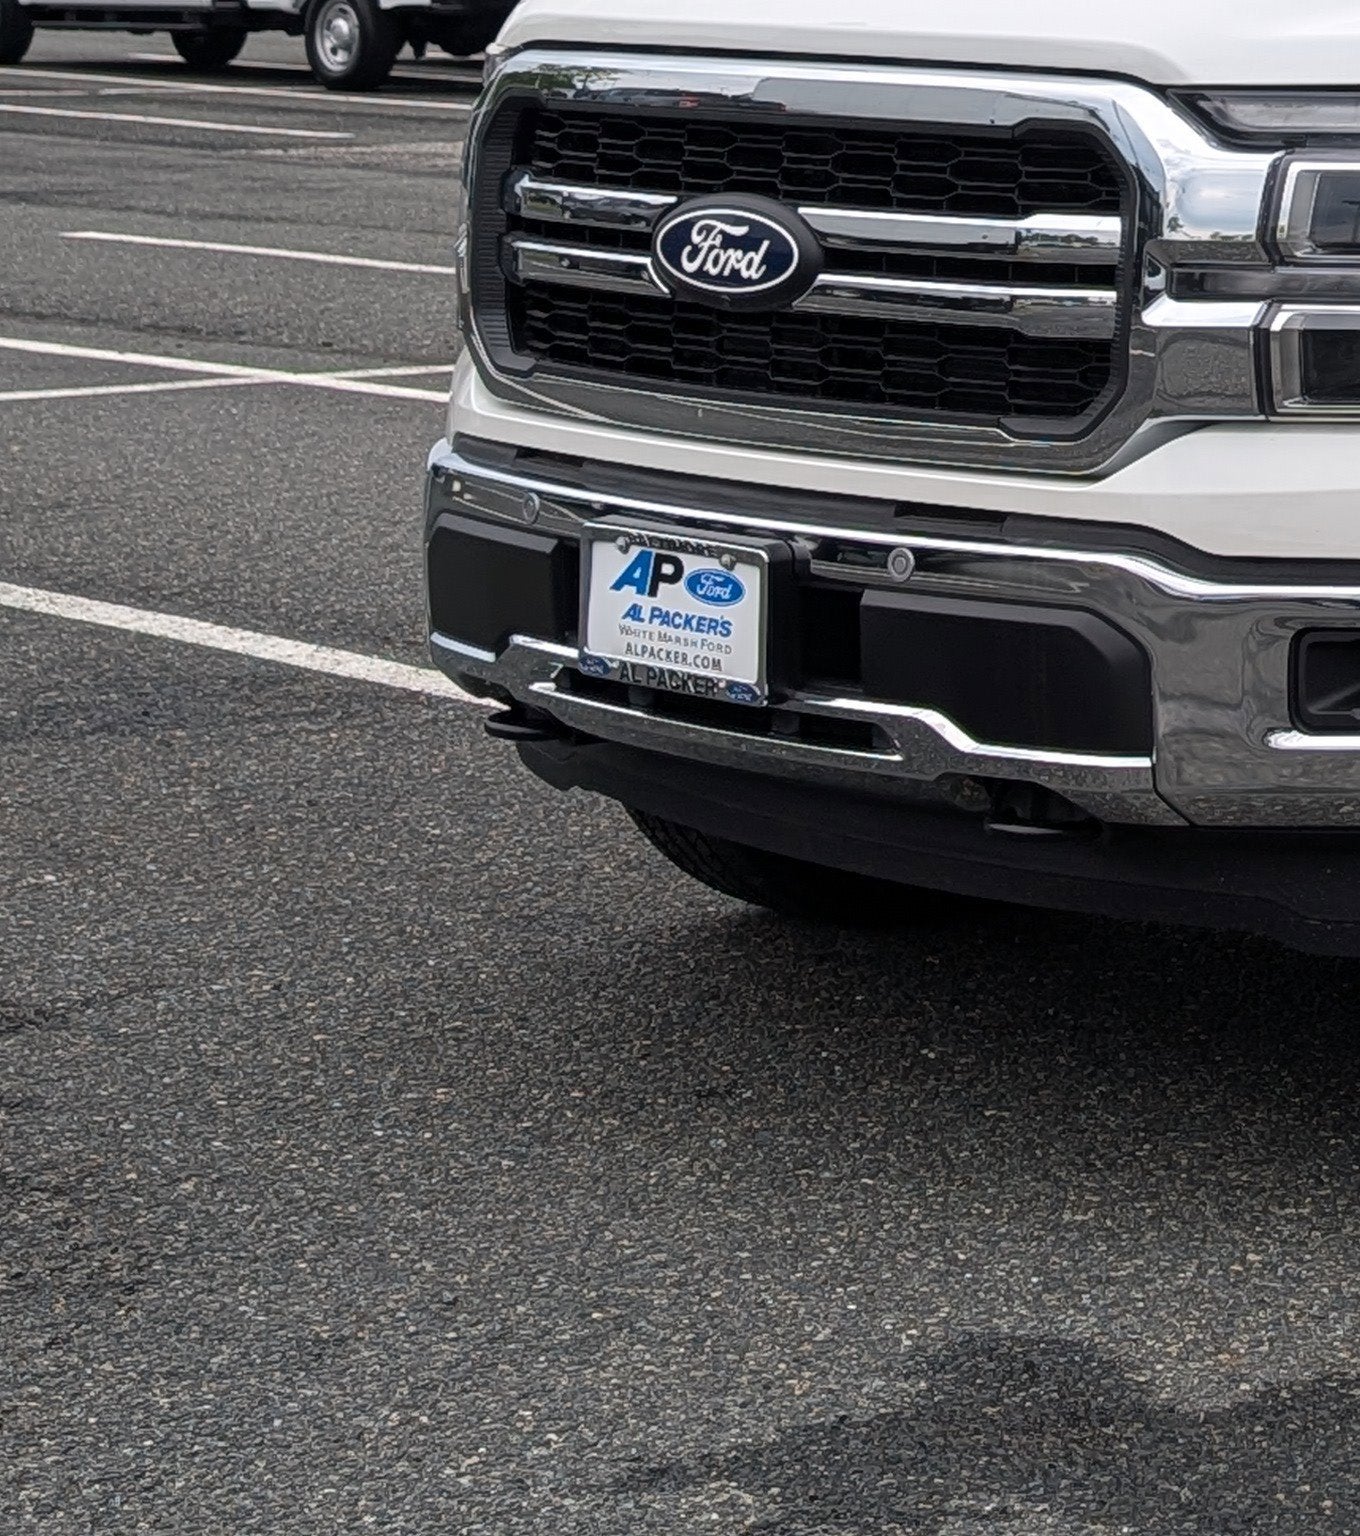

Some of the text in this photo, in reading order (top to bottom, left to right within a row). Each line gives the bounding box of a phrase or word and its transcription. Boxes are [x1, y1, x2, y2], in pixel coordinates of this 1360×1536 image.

[681, 219, 770, 280] Ford
[609, 549, 685, 598] AP
[696, 573, 733, 600] Ford
[621, 603, 733, 638] AL PACKER'S
[625, 642, 723, 672] ALPACKER.COM
[619, 662, 719, 697] AL PACKER
